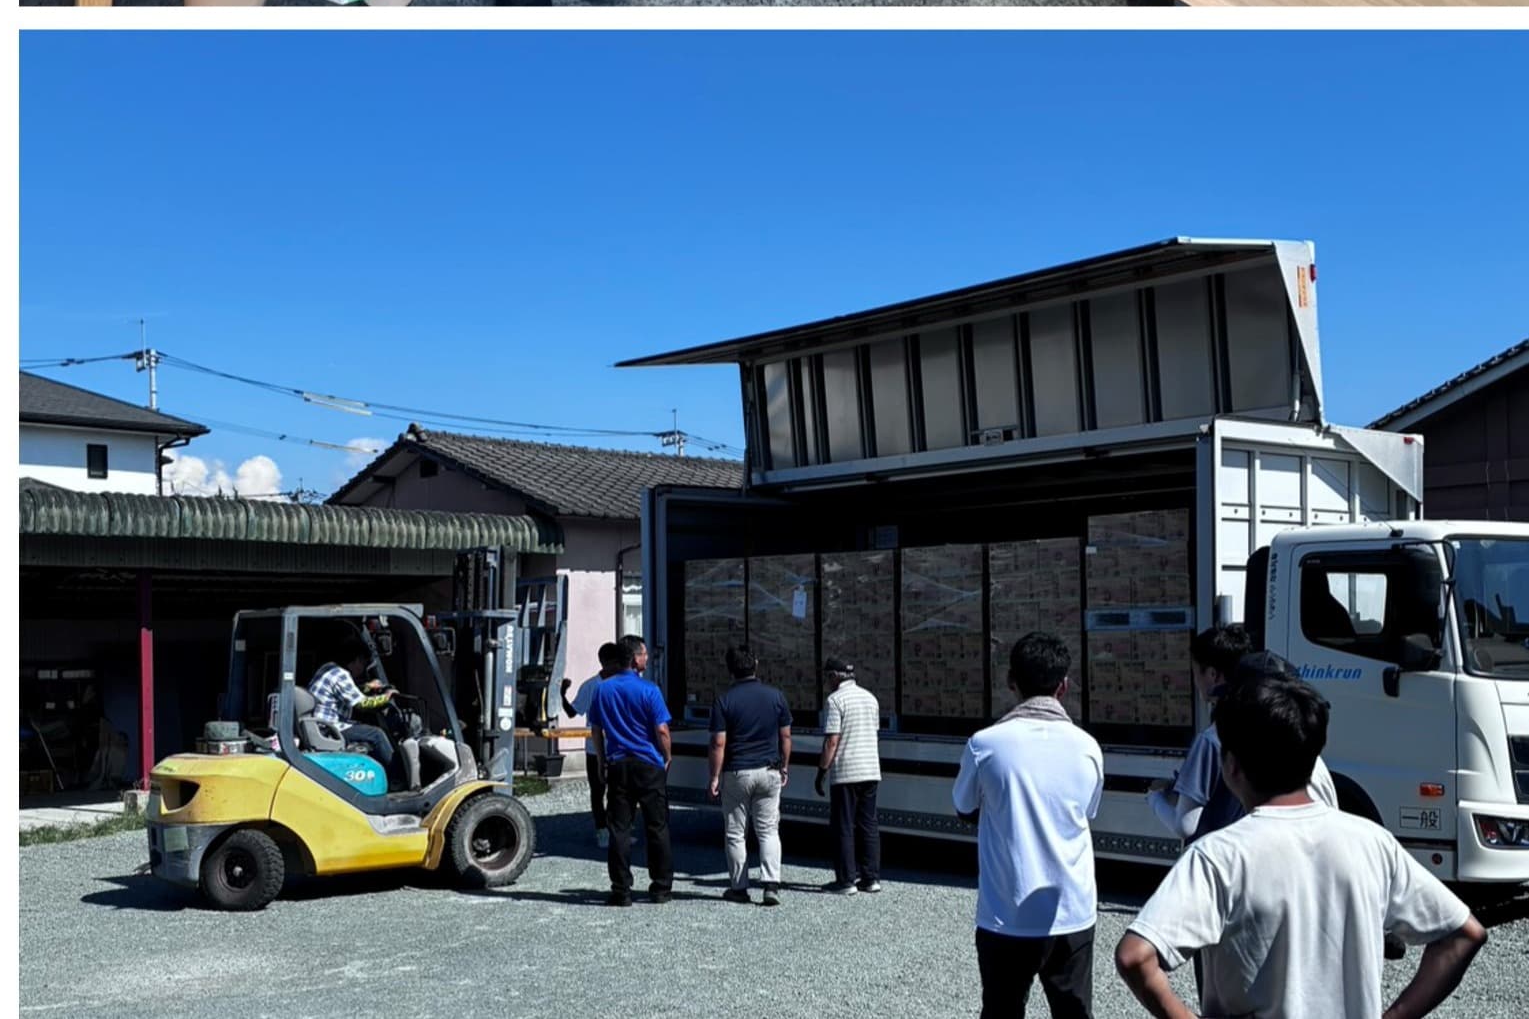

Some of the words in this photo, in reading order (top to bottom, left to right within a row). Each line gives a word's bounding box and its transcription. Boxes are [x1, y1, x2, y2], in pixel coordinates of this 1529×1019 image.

[505, 625, 514, 673] KOMATSU
[1295, 663, 1363, 679] thinkrun
[1401, 810, 1439, 830] 一般
